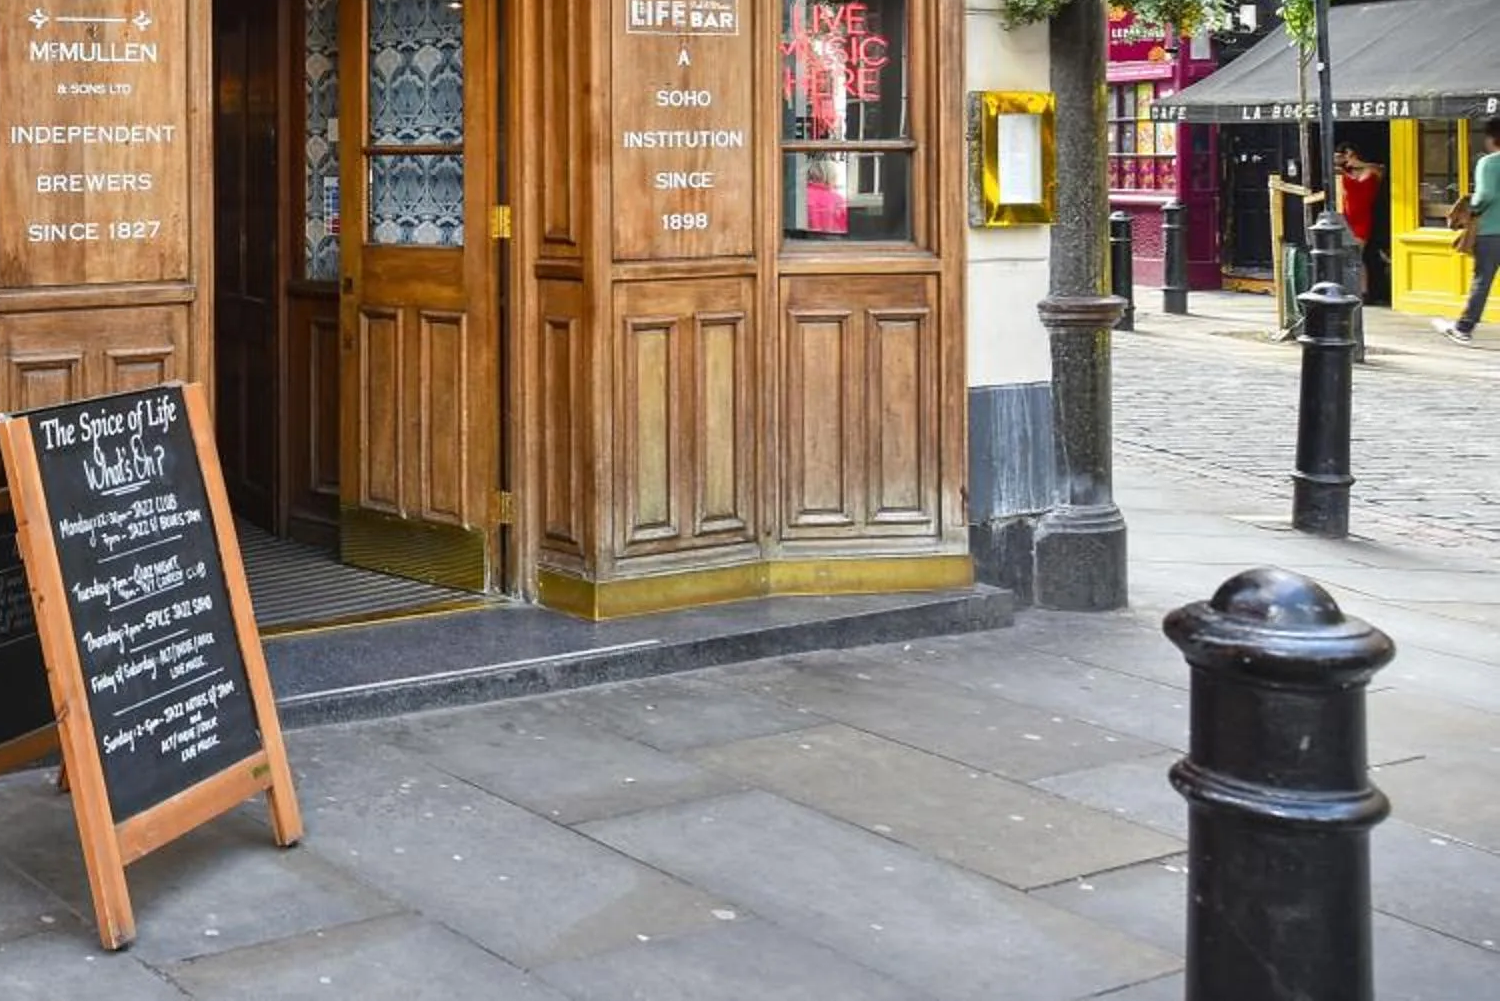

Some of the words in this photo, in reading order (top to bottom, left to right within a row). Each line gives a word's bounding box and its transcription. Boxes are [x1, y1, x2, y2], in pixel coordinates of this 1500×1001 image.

[631, 0, 686, 26] LIFE
[691, 10, 733, 28] BAR
[792, 2, 868, 35] LIVE
[677, 49, 691, 67] A
[57, 83, 68, 94] &
[70, 83, 105, 95] SONS
[109, 84, 132, 95] LTD
[784, 66, 881, 101] HERE
[655, 91, 711, 107] SOHO
[1151, 105, 1188, 120] CAFE
[1241, 106, 1261, 120] LA
[1350, 101, 1409, 117] NEGRA
[11, 125, 176, 145] INDEPENDENT
[623, 130, 743, 148] INSTITUTION
[36, 174, 152, 192] BREWERS
[655, 172, 714, 189] SINCE
[28, 222, 99, 242] SINCE
[108, 221, 160, 240] 1827
[661, 214, 708, 231] 1898
[39, 418, 76, 450] The
[79, 407, 125, 444] Spice
[127, 400, 143, 437] of
[146, 394, 177, 434] Life
[83, 445, 134, 491] What's
